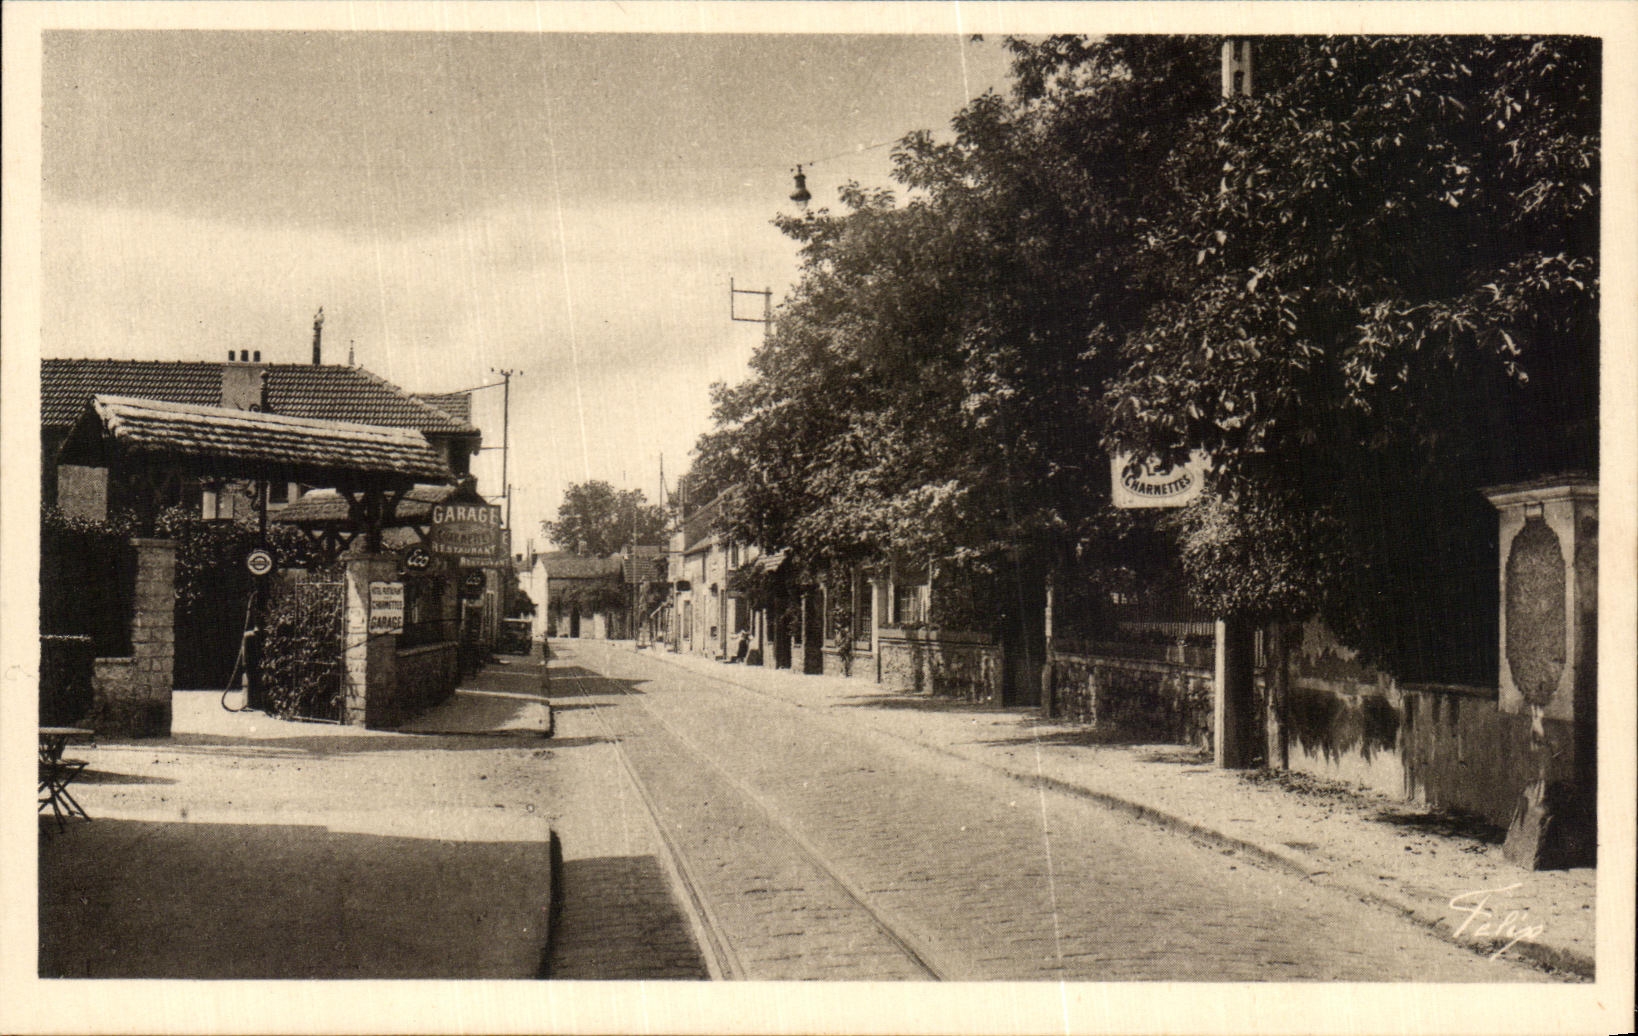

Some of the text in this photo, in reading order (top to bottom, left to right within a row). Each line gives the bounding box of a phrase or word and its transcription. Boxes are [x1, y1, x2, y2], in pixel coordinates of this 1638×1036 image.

[433, 505, 499, 524] GARAGE
[432, 541, 496, 554] RESTAURANT
[407, 548, 430, 567] Eco
[370, 616, 402, 629] GARAGE
